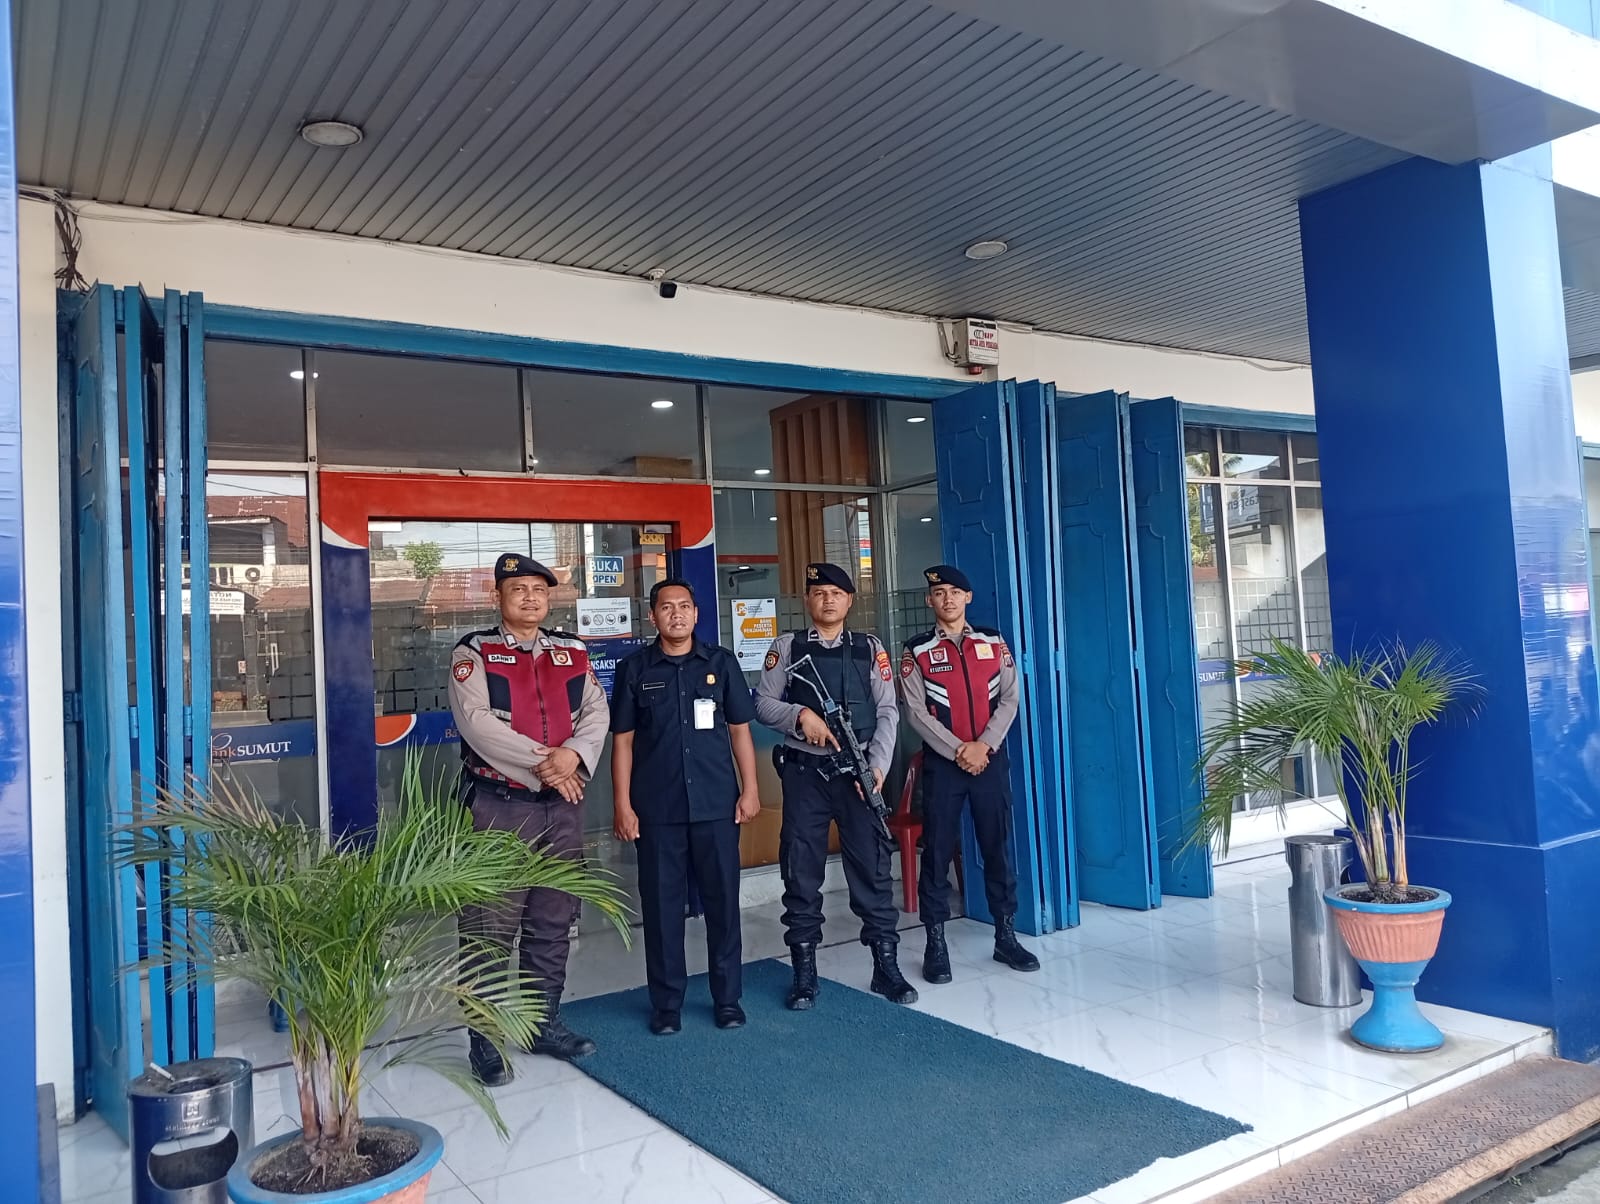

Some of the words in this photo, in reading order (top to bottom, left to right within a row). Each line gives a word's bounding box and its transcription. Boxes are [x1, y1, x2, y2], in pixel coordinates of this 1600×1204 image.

[589, 560, 619, 572] BUKA
[592, 574, 617, 583] OPEN
[590, 659, 616, 670] NSAKSI
[212, 746, 236, 757] ank
[237, 741, 292, 756] SUMUT
